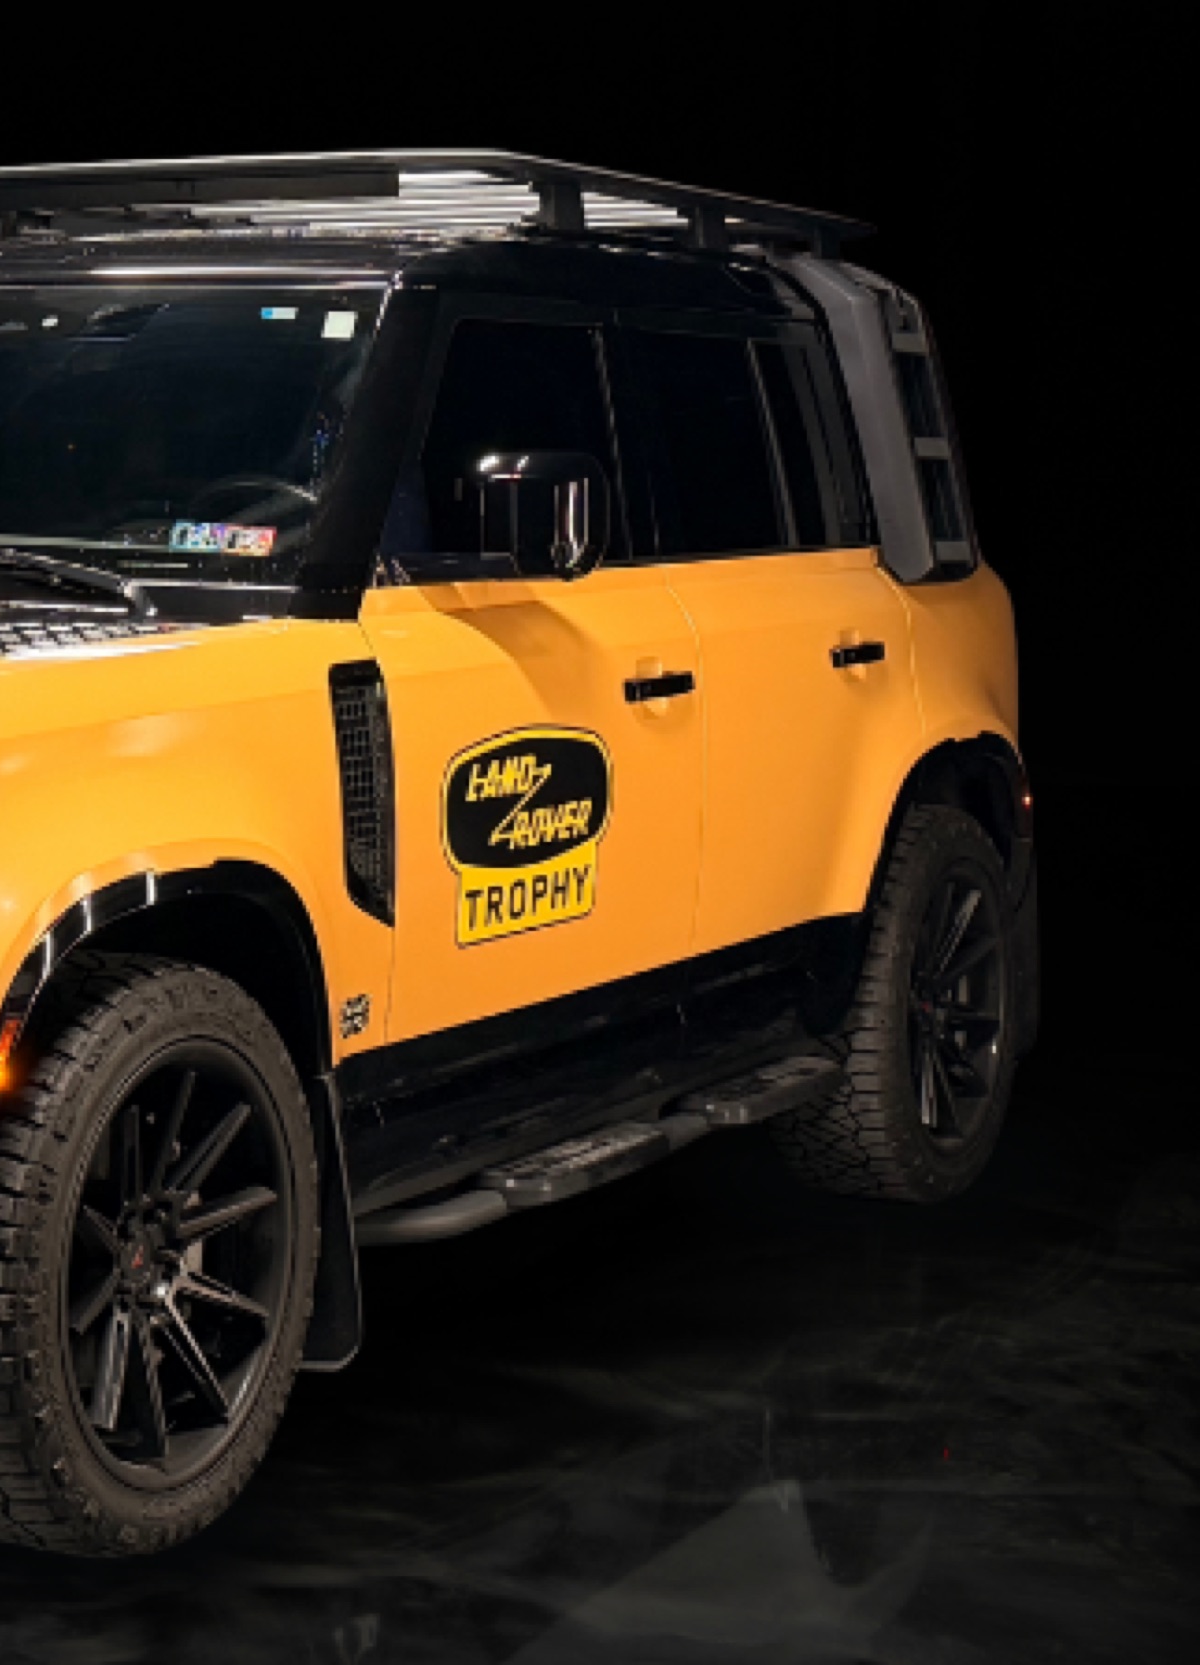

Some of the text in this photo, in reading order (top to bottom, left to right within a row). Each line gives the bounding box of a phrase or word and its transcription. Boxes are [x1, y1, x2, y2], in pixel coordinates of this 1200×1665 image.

[465, 754, 551, 801] LAND
[488, 797, 593, 849] ROVER
[465, 865, 589, 931] TROPHY
